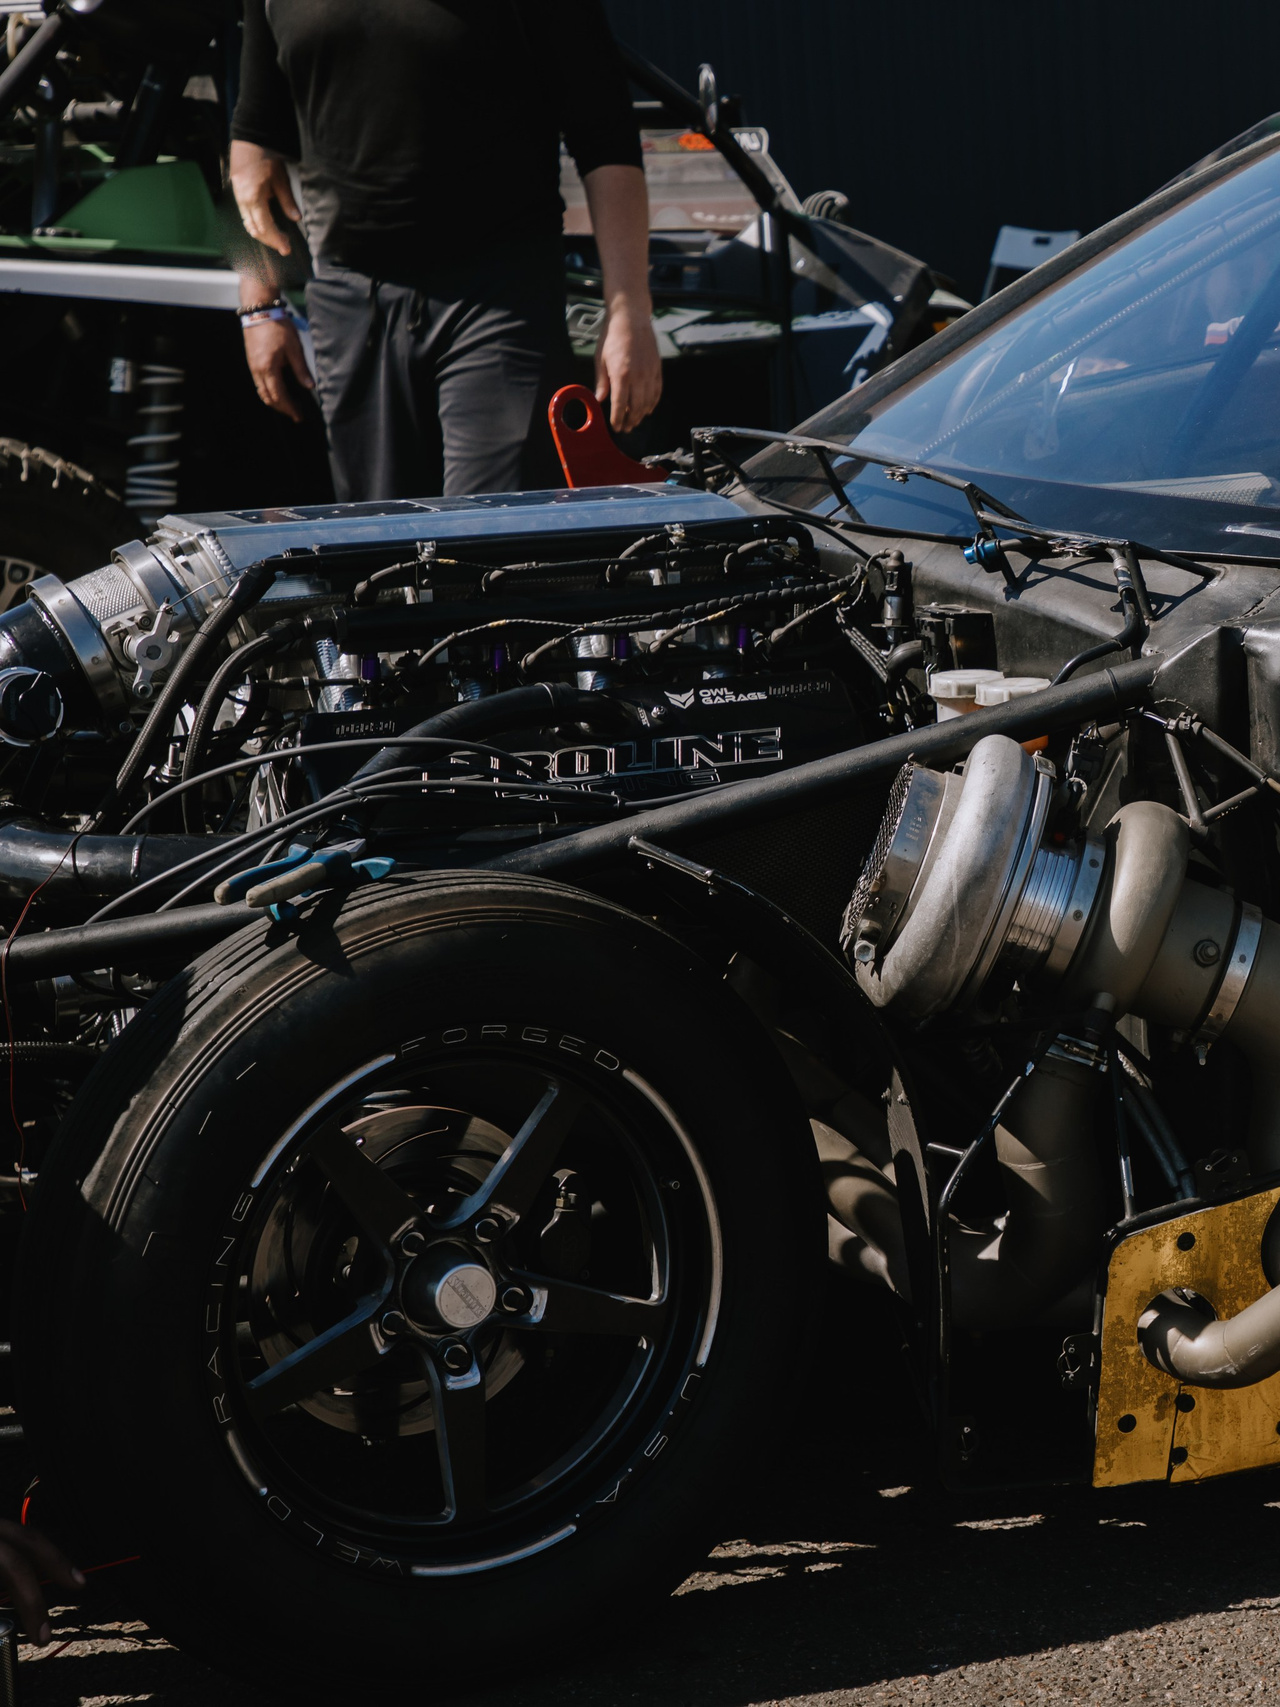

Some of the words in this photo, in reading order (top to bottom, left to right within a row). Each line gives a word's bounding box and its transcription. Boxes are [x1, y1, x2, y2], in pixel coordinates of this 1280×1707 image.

[698, 687, 734, 698] OWL
[701, 691, 768, 705] GARAGE
[399, 1023, 621, 1072] FORGED
[205, 1191, 255, 1425] RACING
[266, 1494, 404, 1577] WELD
